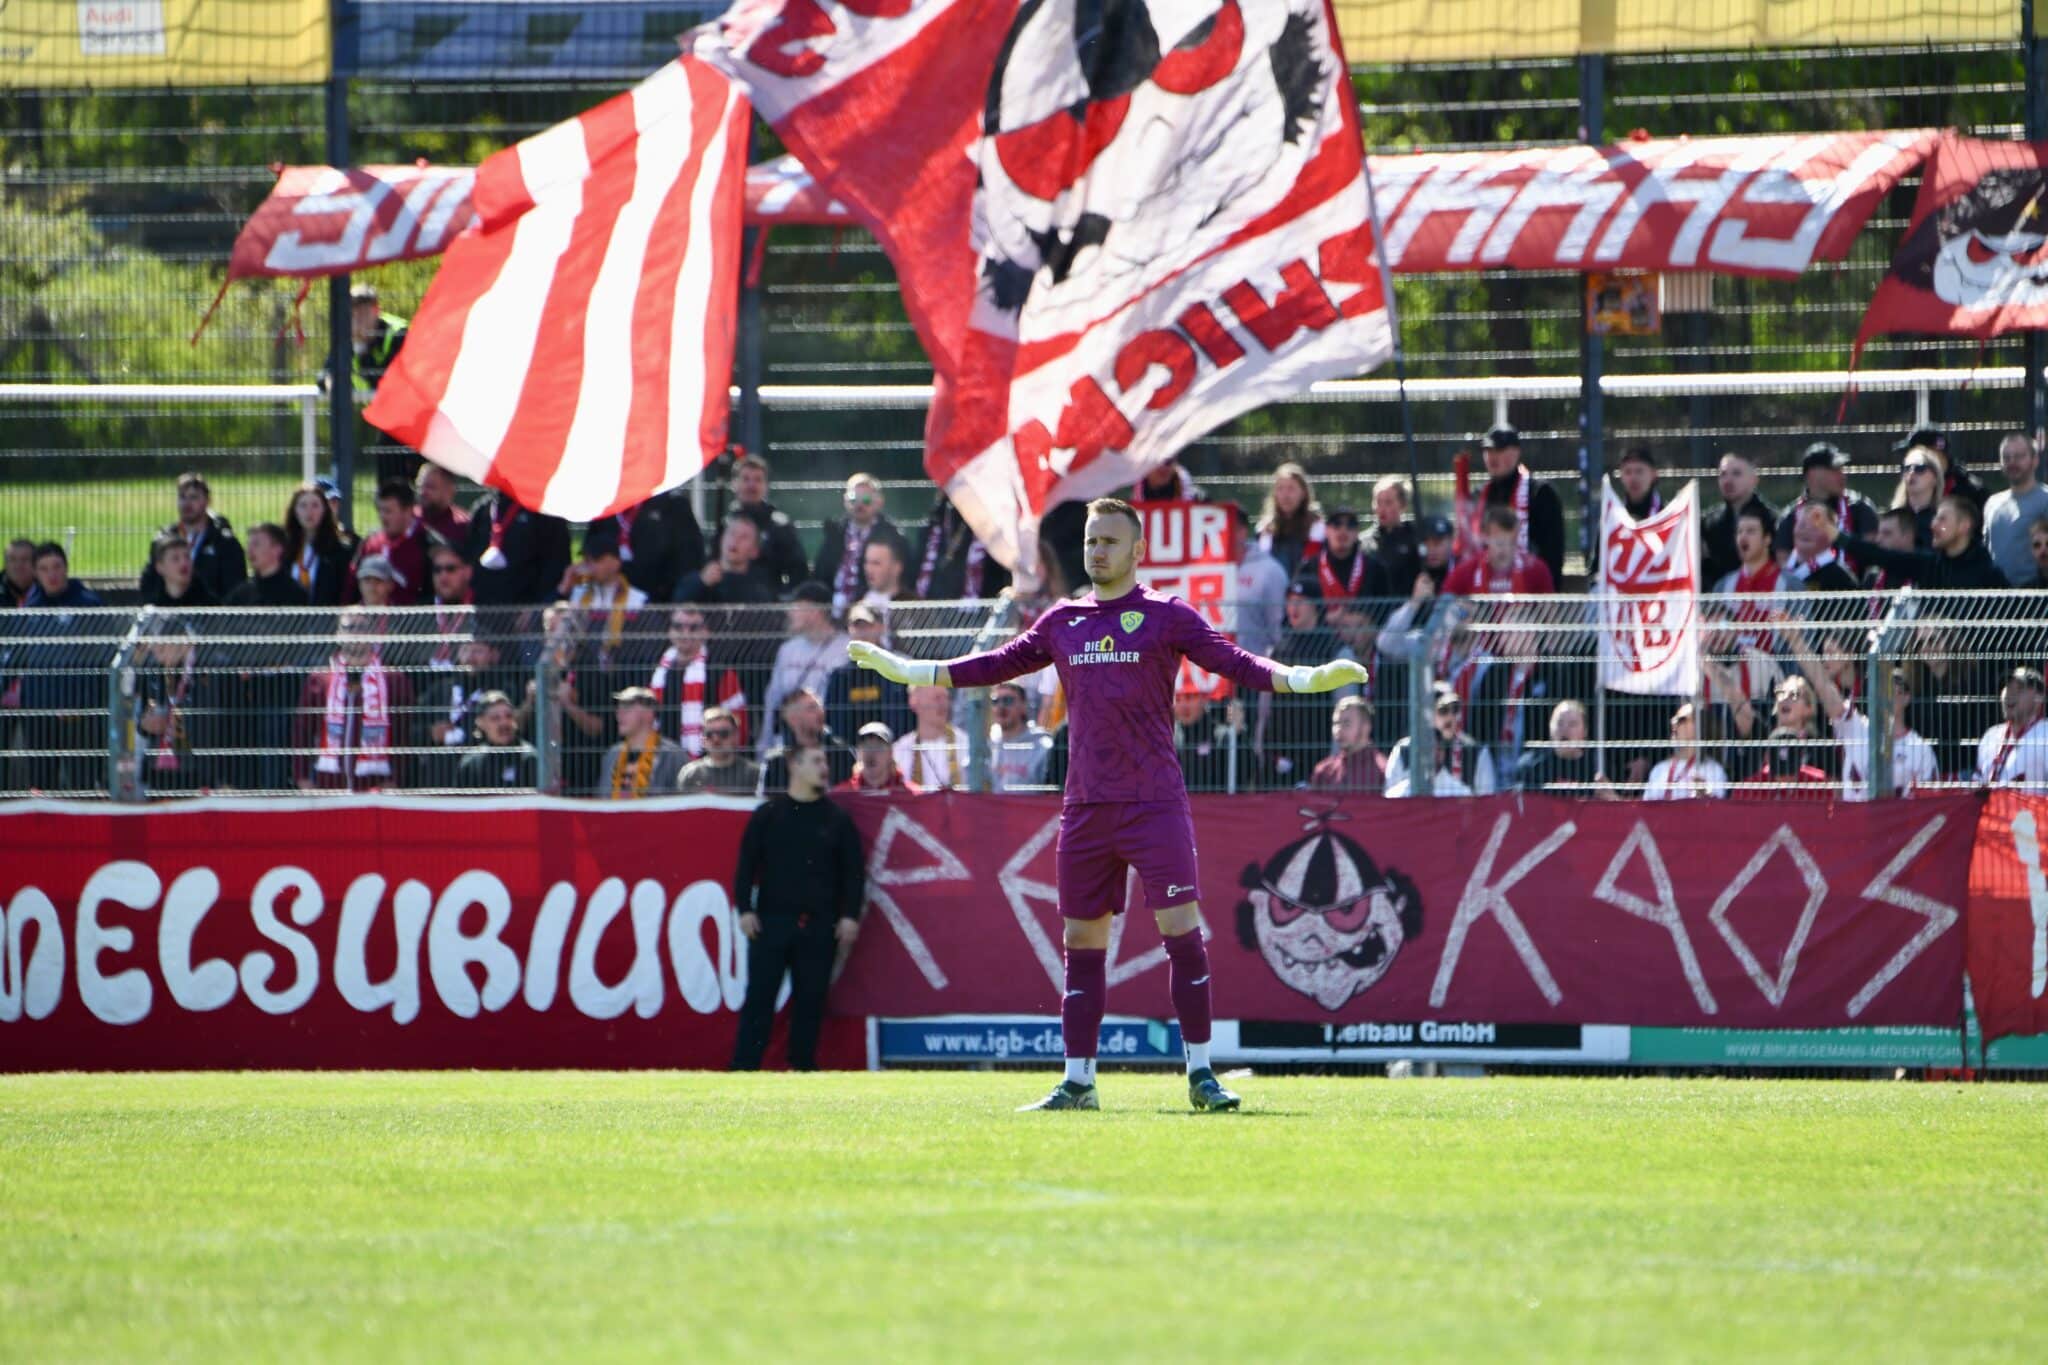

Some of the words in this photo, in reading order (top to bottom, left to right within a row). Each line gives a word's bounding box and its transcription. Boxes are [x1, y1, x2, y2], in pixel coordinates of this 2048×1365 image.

[87, 7, 133, 24] Audi
[1139, 506, 1228, 563] UR
[1085, 641, 1101, 653] DIE
[1069, 652, 1140, 666] LUCKENWALDER
[1429, 812, 1959, 1018] KAOS
[1419, 1020, 1496, 1043] GmbH
